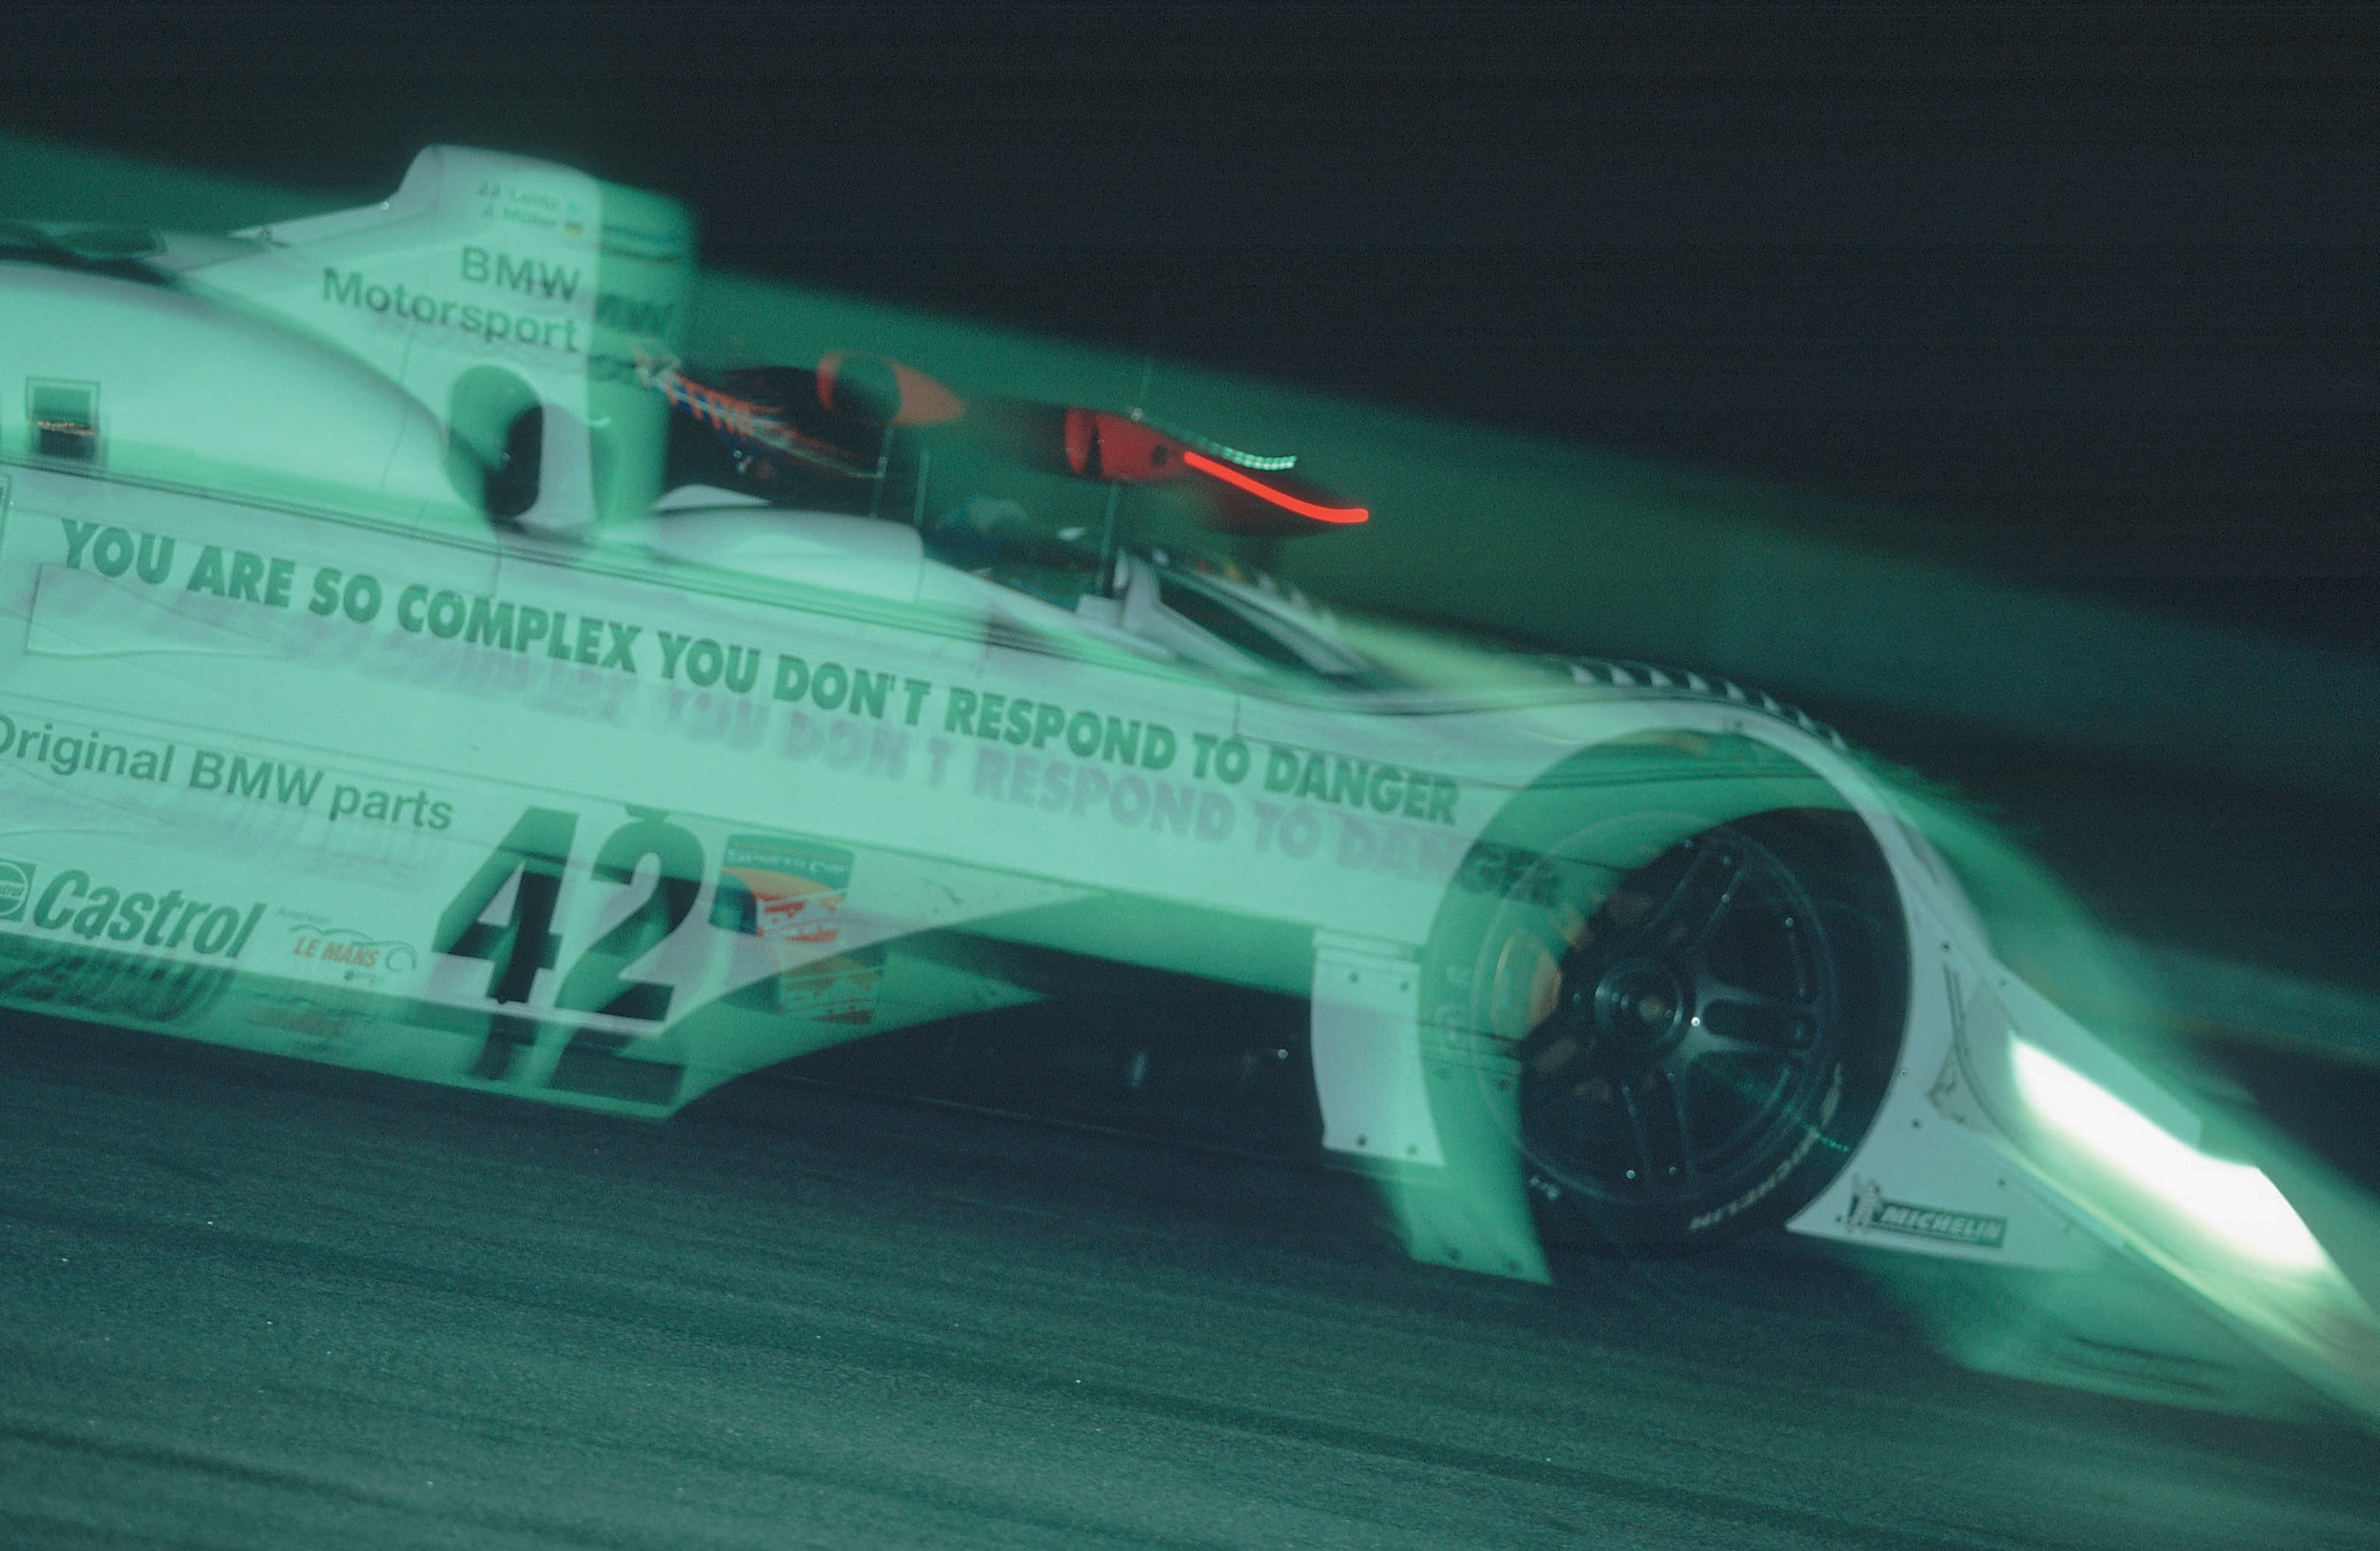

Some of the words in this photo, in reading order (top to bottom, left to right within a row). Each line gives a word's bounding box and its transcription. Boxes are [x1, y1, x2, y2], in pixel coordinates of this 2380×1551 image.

[322, 267, 580, 353] Motorsport
[461, 245, 582, 302] BMW
[61, 518, 176, 586] YOU
[187, 545, 296, 608] ARE
[308, 568, 383, 624] SO
[397, 583, 643, 674] COMPLEX
[658, 630, 762, 694] YOU
[773, 653, 931, 726] DON'T
[945, 685, 1178, 769] RESPOND
[1192, 731, 1251, 785] TO
[1262, 743, 1460, 825] DANGER
[188, 747, 326, 809] BMW
[328, 779, 455, 832] parts
[34, 868, 267, 959] Castrol
[292, 935, 321, 958] LE
[321, 942, 381, 968] MANS
[432, 805, 705, 1022] 42
[1879, 1204, 2002, 1238] MICHELIN
